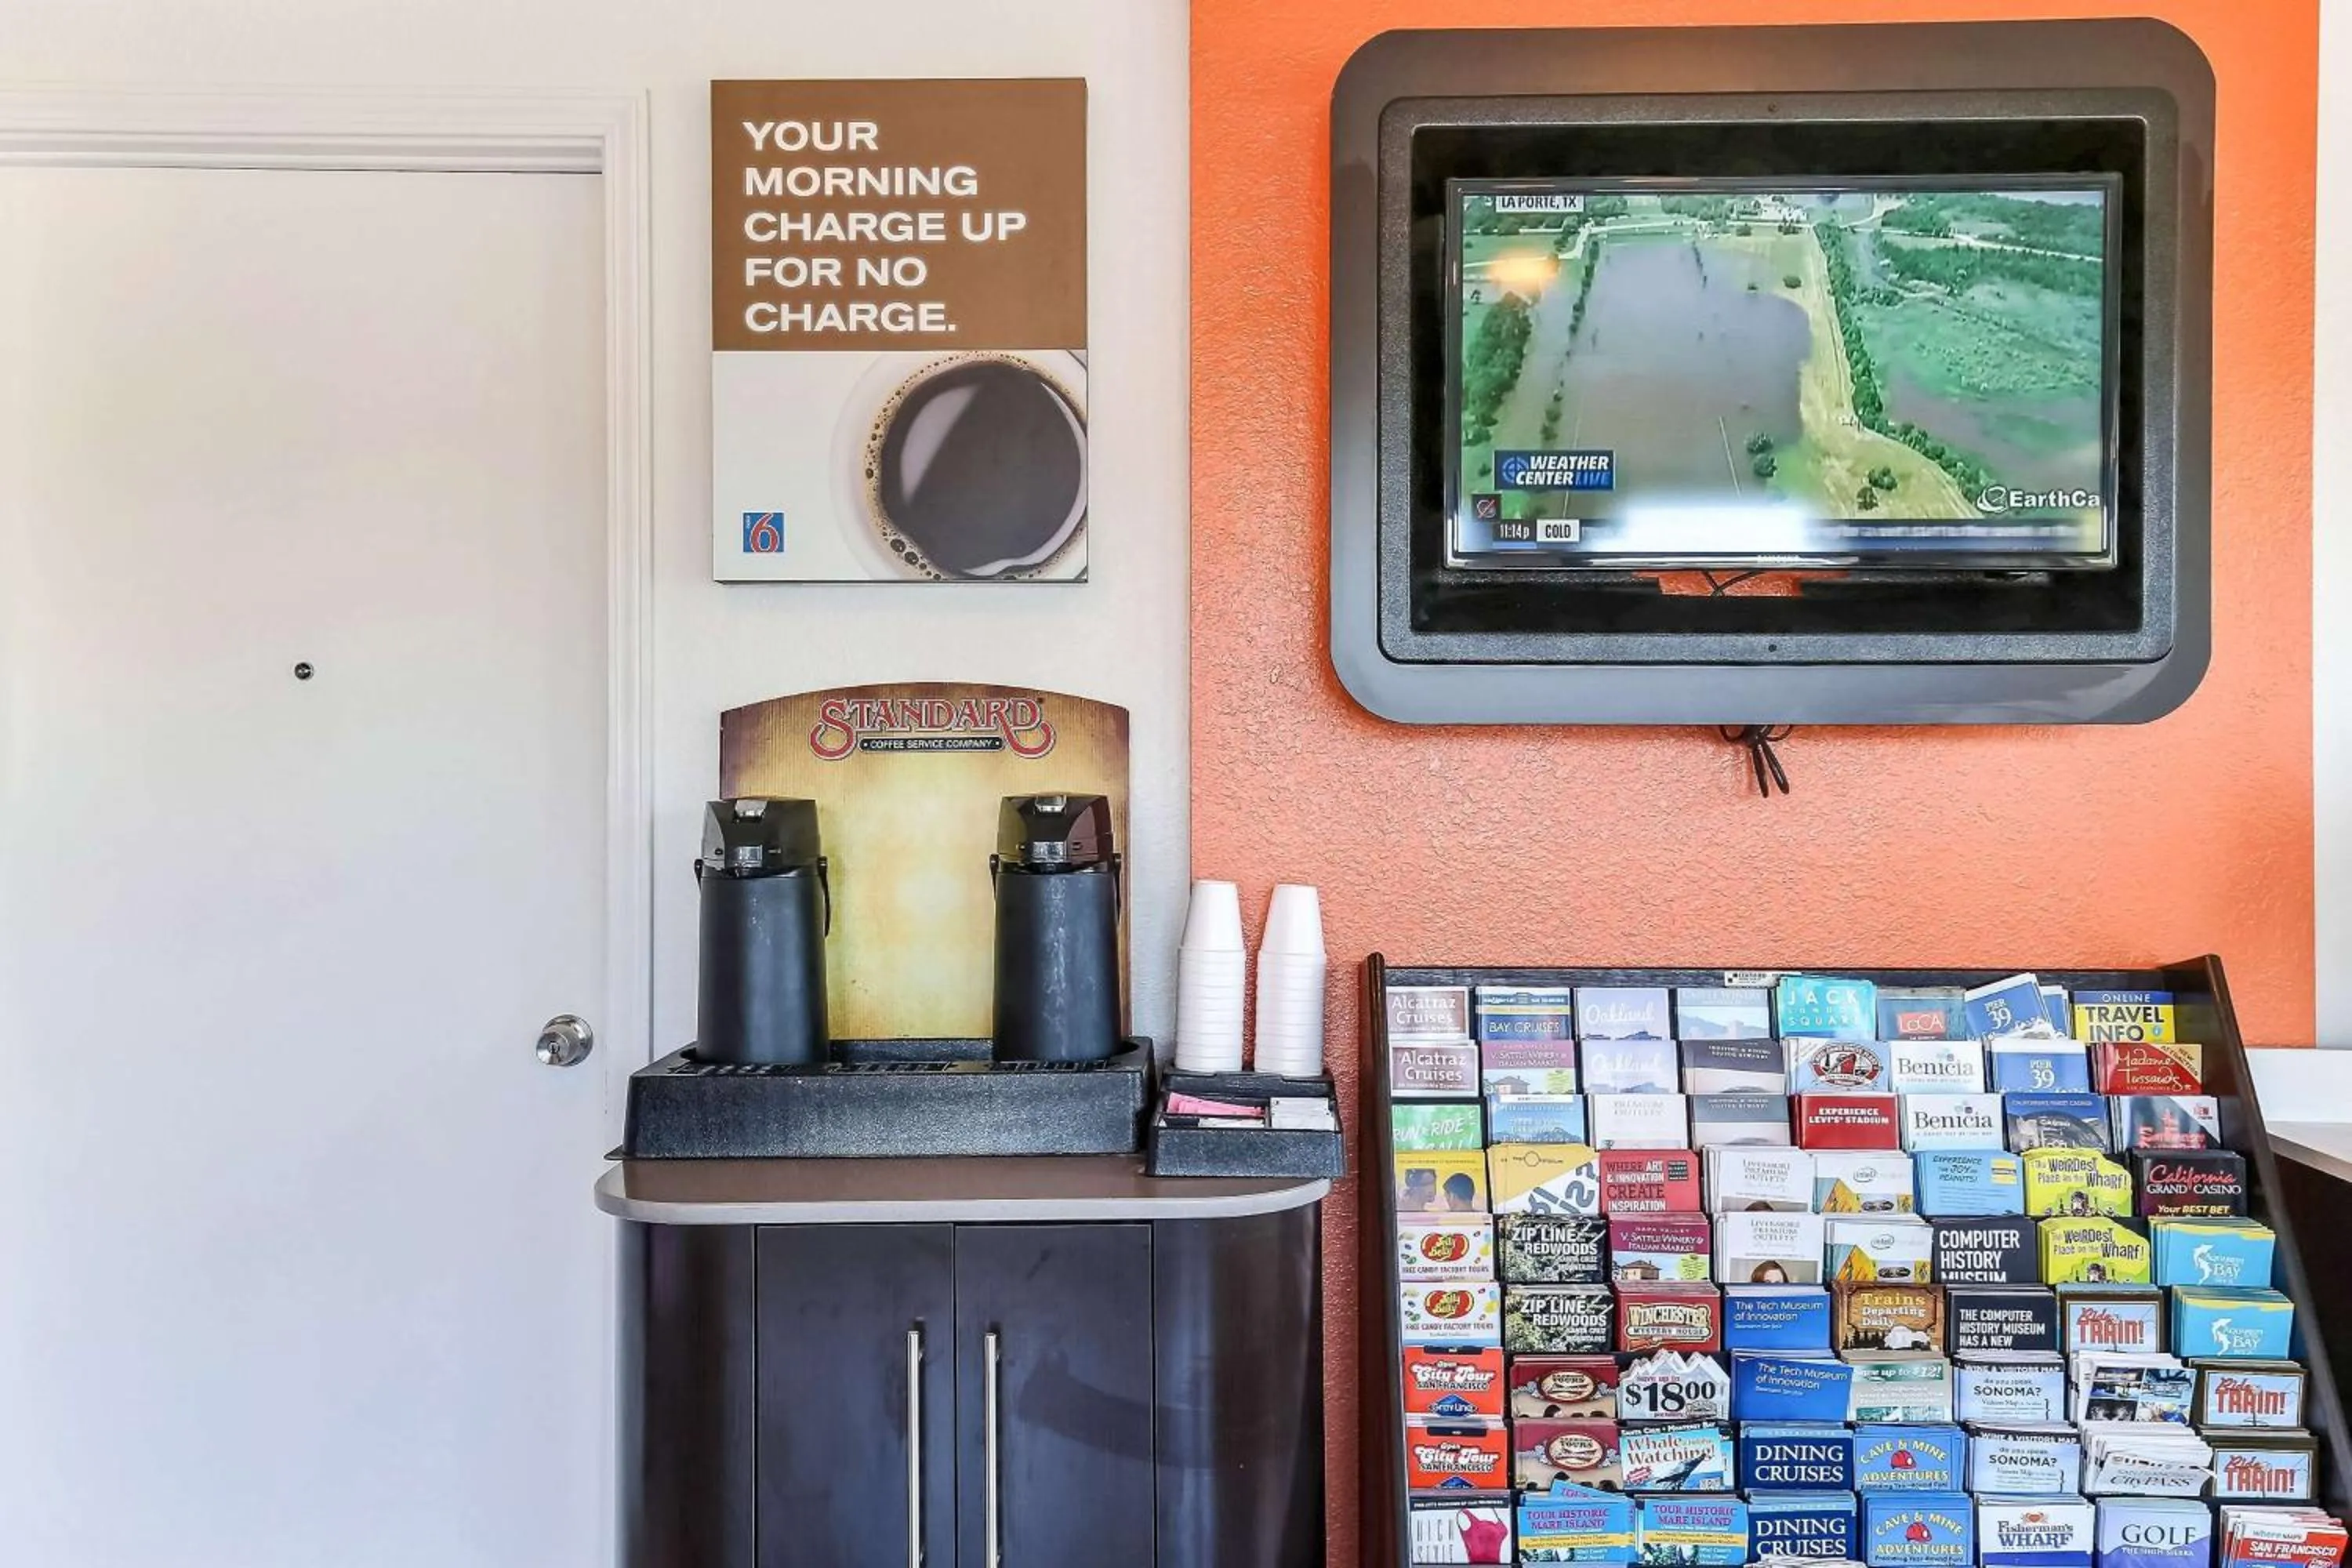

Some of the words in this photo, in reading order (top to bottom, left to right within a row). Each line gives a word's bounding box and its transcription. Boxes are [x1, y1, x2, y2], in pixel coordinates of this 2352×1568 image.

[743, 122, 879, 151] YOUR
[745, 167, 978, 197] MORNING
[1501, 197, 1516, 209] LA
[1518, 197, 1559, 209] PORTE,
[1563, 197, 1577, 209] TX
[744, 212, 946, 241] CHARGE
[962, 212, 1026, 241] UP
[746, 258, 841, 287] FOR
[857, 258, 927, 288] NO
[745, 303, 956, 332] CHARGE.
[1530, 456, 1610, 470] WEATHER
[1516, 471, 1573, 485] CENTER
[1575, 472, 1611, 485] LIVE
[750, 513, 779, 552] 6
[1545, 524, 1572, 539] COLD
[809, 698, 1056, 760] STANDARD
[870, 739, 905, 750] COFFEE
[907, 739, 944, 750] SERVICE
[946, 739, 992, 750] COMPANY
[1392, 995, 1456, 1009] Alcatraz
[1788, 990, 1857, 1005] JACK
[2103, 994, 2151, 1003] ONLINE
[1584, 1001, 1655, 1025] Oakland
[1984, 999, 2006, 1012] PIER
[1396, 1010, 1454, 1024] Cruises
[1988, 1007, 2012, 1029] 39
[2085, 1007, 2165, 1023] TRAVEL
[1489, 1022, 1510, 1033] BAY
[1514, 1022, 1560, 1033] CRUISES
[2089, 1025, 2144, 1042] INFO
[1401, 1051, 1467, 1065] Alcatraz
[2030, 1060, 2053, 1069] PIER
[2115, 1048, 2175, 1067] Madame
[1405, 1067, 1463, 1081] Cruises
[1897, 1058, 1974, 1076] Benicia
[2031, 1069, 2055, 1088] 39
[2117, 1066, 2183, 1091] Tussauds
[1431, 1117, 1465, 1136] RIDE
[1915, 1110, 1993, 1128] Benicia
[1606, 1162, 1643, 1171] WHERE
[1646, 1160, 1663, 1171] ART
[1933, 1156, 1982, 1164] EXPERIENCE
[1951, 1164, 1970, 1174] JOY
[1614, 1173, 1664, 1183] INNOVATION
[2150, 1164, 2237, 1190] California
[1606, 1184, 1665, 1199] CREATE
[2147, 1185, 2187, 1194] GRAND
[2194, 1185, 2241, 1194] CASINO
[1608, 1200, 1665, 1211] INSPIRATION
[2182, 1205, 2207, 1214] BEST
[2209, 1205, 2230, 1214] BET
[1512, 1226, 1537, 1241] ZIP
[1541, 1227, 1577, 1242] LINE
[1939, 1230, 2020, 1249] COMPUTER
[1524, 1243, 1597, 1254] REDWOODS
[1628, 1242, 1659, 1250] ITALIAN
[1661, 1243, 1694, 1252] MARKET
[1940, 1251, 2002, 1269] HISTORY
[1940, 1271, 2007, 1282] MUSEUM
[1520, 1299, 1546, 1313] ZIP
[1550, 1299, 1586, 1314] LINE
[1735, 1301, 1754, 1310] The
[1756, 1301, 1779, 1310] Tech
[1780, 1301, 1824, 1310] Museum
[1861, 1294, 1926, 1306] Trains
[1628, 1305, 1708, 1327] WINCHESTER
[1734, 1312, 1744, 1321] of
[1747, 1312, 1798, 1321] Innovation
[1861, 1307, 1926, 1318] Departing
[1959, 1309, 1977, 1320] THE
[1980, 1310, 2033, 1321] COMPUTER
[2078, 1307, 2111, 1325] Ride
[1533, 1314, 1606, 1327] REDWOODS
[1862, 1317, 1895, 1328] Daily
[1959, 1323, 2000, 1334] HISTORY
[2002, 1323, 2045, 1334] MUSEUM
[1960, 1336, 1980, 1347] HAS
[1982, 1336, 1989, 1346] A
[1991, 1336, 2013, 1347] NEW
[1411, 1364, 1453, 1382] City
[1454, 1366, 1496, 1382] Tour
[1758, 1363, 1777, 1374] The
[1780, 1366, 1802, 1376] Tech
[1804, 1368, 1848, 1381] Museum
[1756, 1376, 1766, 1385] of
[1768, 1377, 1820, 1390] Innovation
[1973, 1385, 2042, 1396] SONOMA?
[2216, 1377, 2250, 1392] Ride
[1627, 1435, 1682, 1451] Whale
[1414, 1446, 1456, 1464] City
[1457, 1447, 1500, 1464] Tour
[1628, 1444, 1715, 1465] Watching!
[1755, 1445, 1843, 1462] DINING
[1860, 1441, 1894, 1465] CAVE
[1897, 1439, 1907, 1450] &
[1912, 1439, 1947, 1462] MINE
[1989, 1454, 2058, 1468] SONOMA?
[2223, 1455, 2261, 1471] Ride
[1755, 1465, 1843, 1482] CRUISES
[1862, 1470, 1949, 1482] ADVENTURES
[1526, 1510, 1556, 1519] TOUR
[1559, 1508, 1610, 1518] HISTORIC
[1653, 1504, 1684, 1514] TOUR
[1686, 1506, 1738, 1517] HISTORIC
[1531, 1520, 1562, 1530] MARE
[1566, 1519, 1606, 1529] ISLAND
[1658, 1515, 1690, 1525] MARE
[1691, 1516, 1732, 1526] ISLAND
[1755, 1518, 1846, 1537] DINING
[1875, 1512, 1909, 1536] CAVE
[1913, 1511, 1924, 1522] &
[1928, 1512, 1962, 1537] MINE
[1997, 1520, 2074, 1534] Fisherman's
[1417, 1519, 1454, 1542] HIGH
[2121, 1524, 2196, 1545] GOLF
[2252, 1530, 2282, 1539] where
[1756, 1539, 1846, 1556] CRUISES
[1997, 1534, 2074, 1549] WHARF
[2249, 1541, 2273, 1552] SAN
[2274, 1544, 2337, 1556] FRANCISCO
[1876, 1544, 1964, 1555] ADVENTURES
[2165, 1548, 2194, 1557] SIERRA
